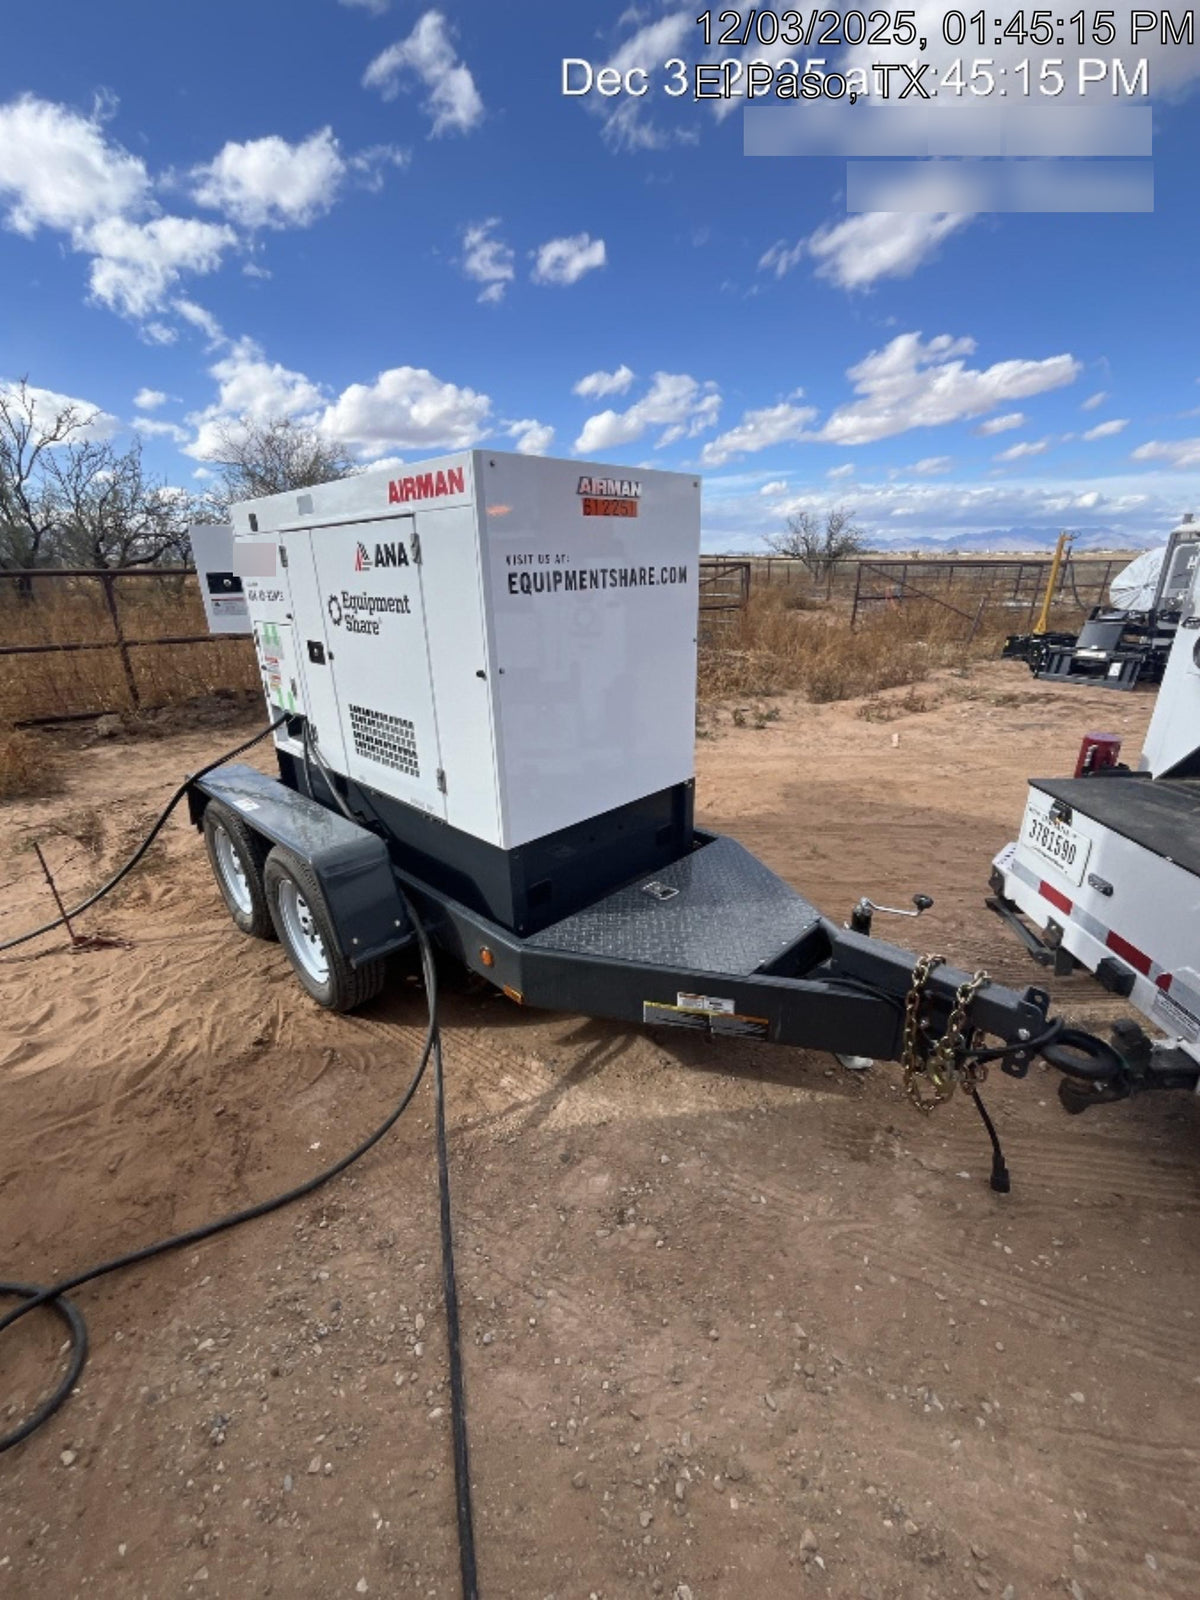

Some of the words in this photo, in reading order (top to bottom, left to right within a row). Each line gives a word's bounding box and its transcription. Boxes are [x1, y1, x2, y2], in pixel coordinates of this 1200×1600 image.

[388, 467, 465, 504] AIRMAN
[577, 476, 643, 498] AIRMAN
[374, 542, 410, 568] ANA
[506, 554, 534, 566] VISIT
[538, 554, 550, 564] US
[508, 565, 688, 596] EQUIPMENTSHARE.COM
[341, 591, 412, 616] Equipment
